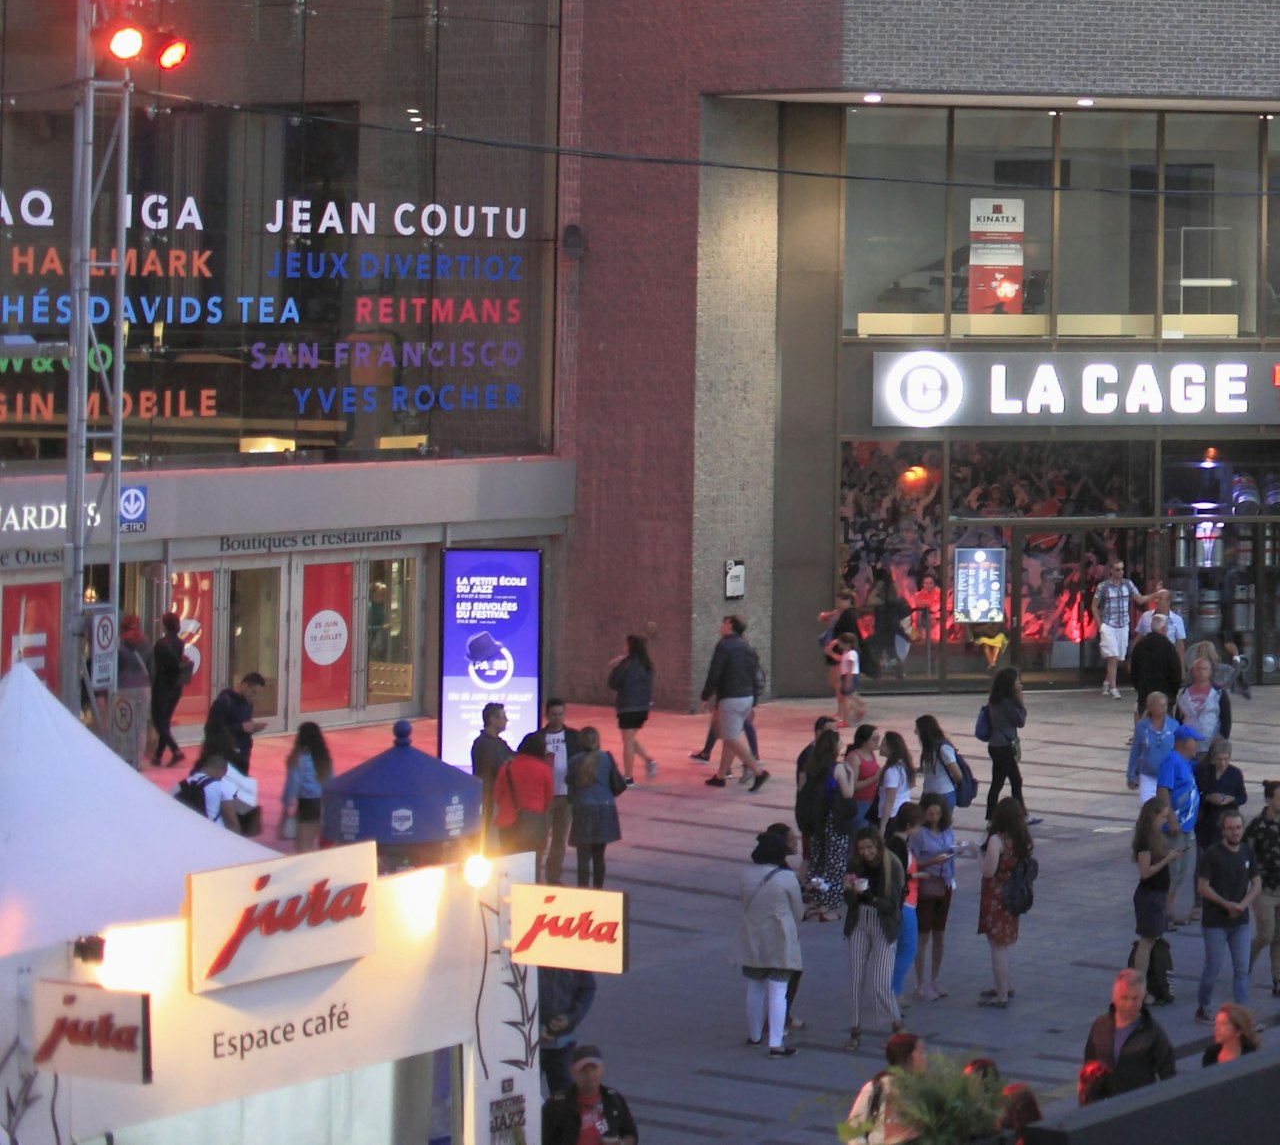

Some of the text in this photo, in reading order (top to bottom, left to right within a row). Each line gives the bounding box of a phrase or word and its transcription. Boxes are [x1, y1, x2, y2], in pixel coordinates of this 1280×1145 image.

[265, 199, 527, 239] JEAN COUTU
[976, 215, 1018, 224] KINATEX
[266, 250, 348, 280] JEUX
[237, 295, 300, 325] TEA
[355, 297, 522, 325] REITMANS
[250, 341, 523, 370] SAN FRANCISCO
[293, 384, 522, 416] YVES ROCHER
[990, 363, 1065, 414] LA
[1082, 363, 1249, 414] CAGE
[219, 528, 402, 553] Boutiques et restaurants
[456, 575, 527, 586] LA PETITE ÉCOLE
[456, 585, 493, 594] DU JAZZ
[456, 602, 472, 611] LES
[456, 610, 510, 619] DU FESTIVAL
[205, 875, 369, 980] jura
[512, 895, 619, 954] jura
[34, 993, 140, 1063] jura
[212, 1003, 350, 1061] Espace café
